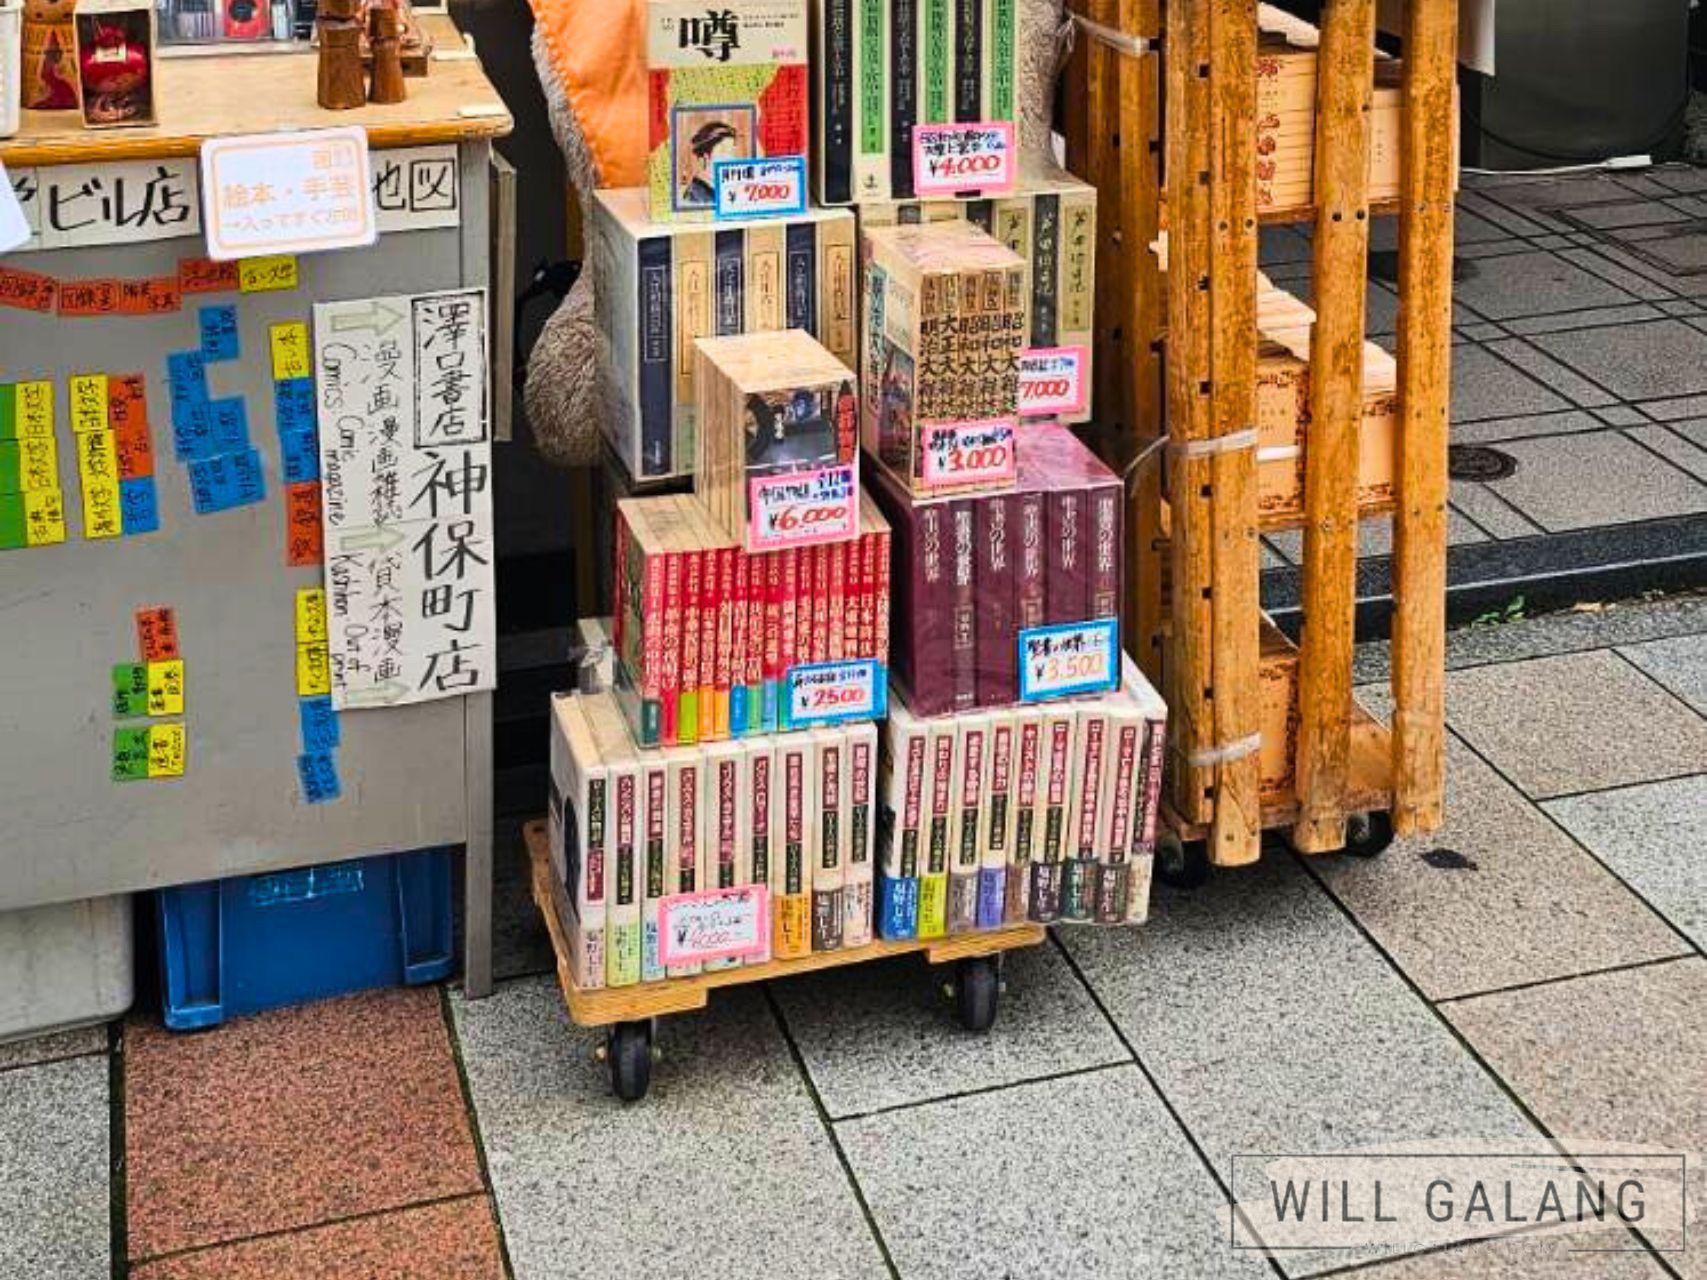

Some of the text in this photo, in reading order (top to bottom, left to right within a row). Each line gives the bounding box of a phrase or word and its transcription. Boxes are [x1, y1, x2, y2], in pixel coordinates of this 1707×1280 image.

[679, 8, 741, 62] 噂
[422, 301, 472, 438] 澤口書店
[410, 449, 488, 692] 神保町店
